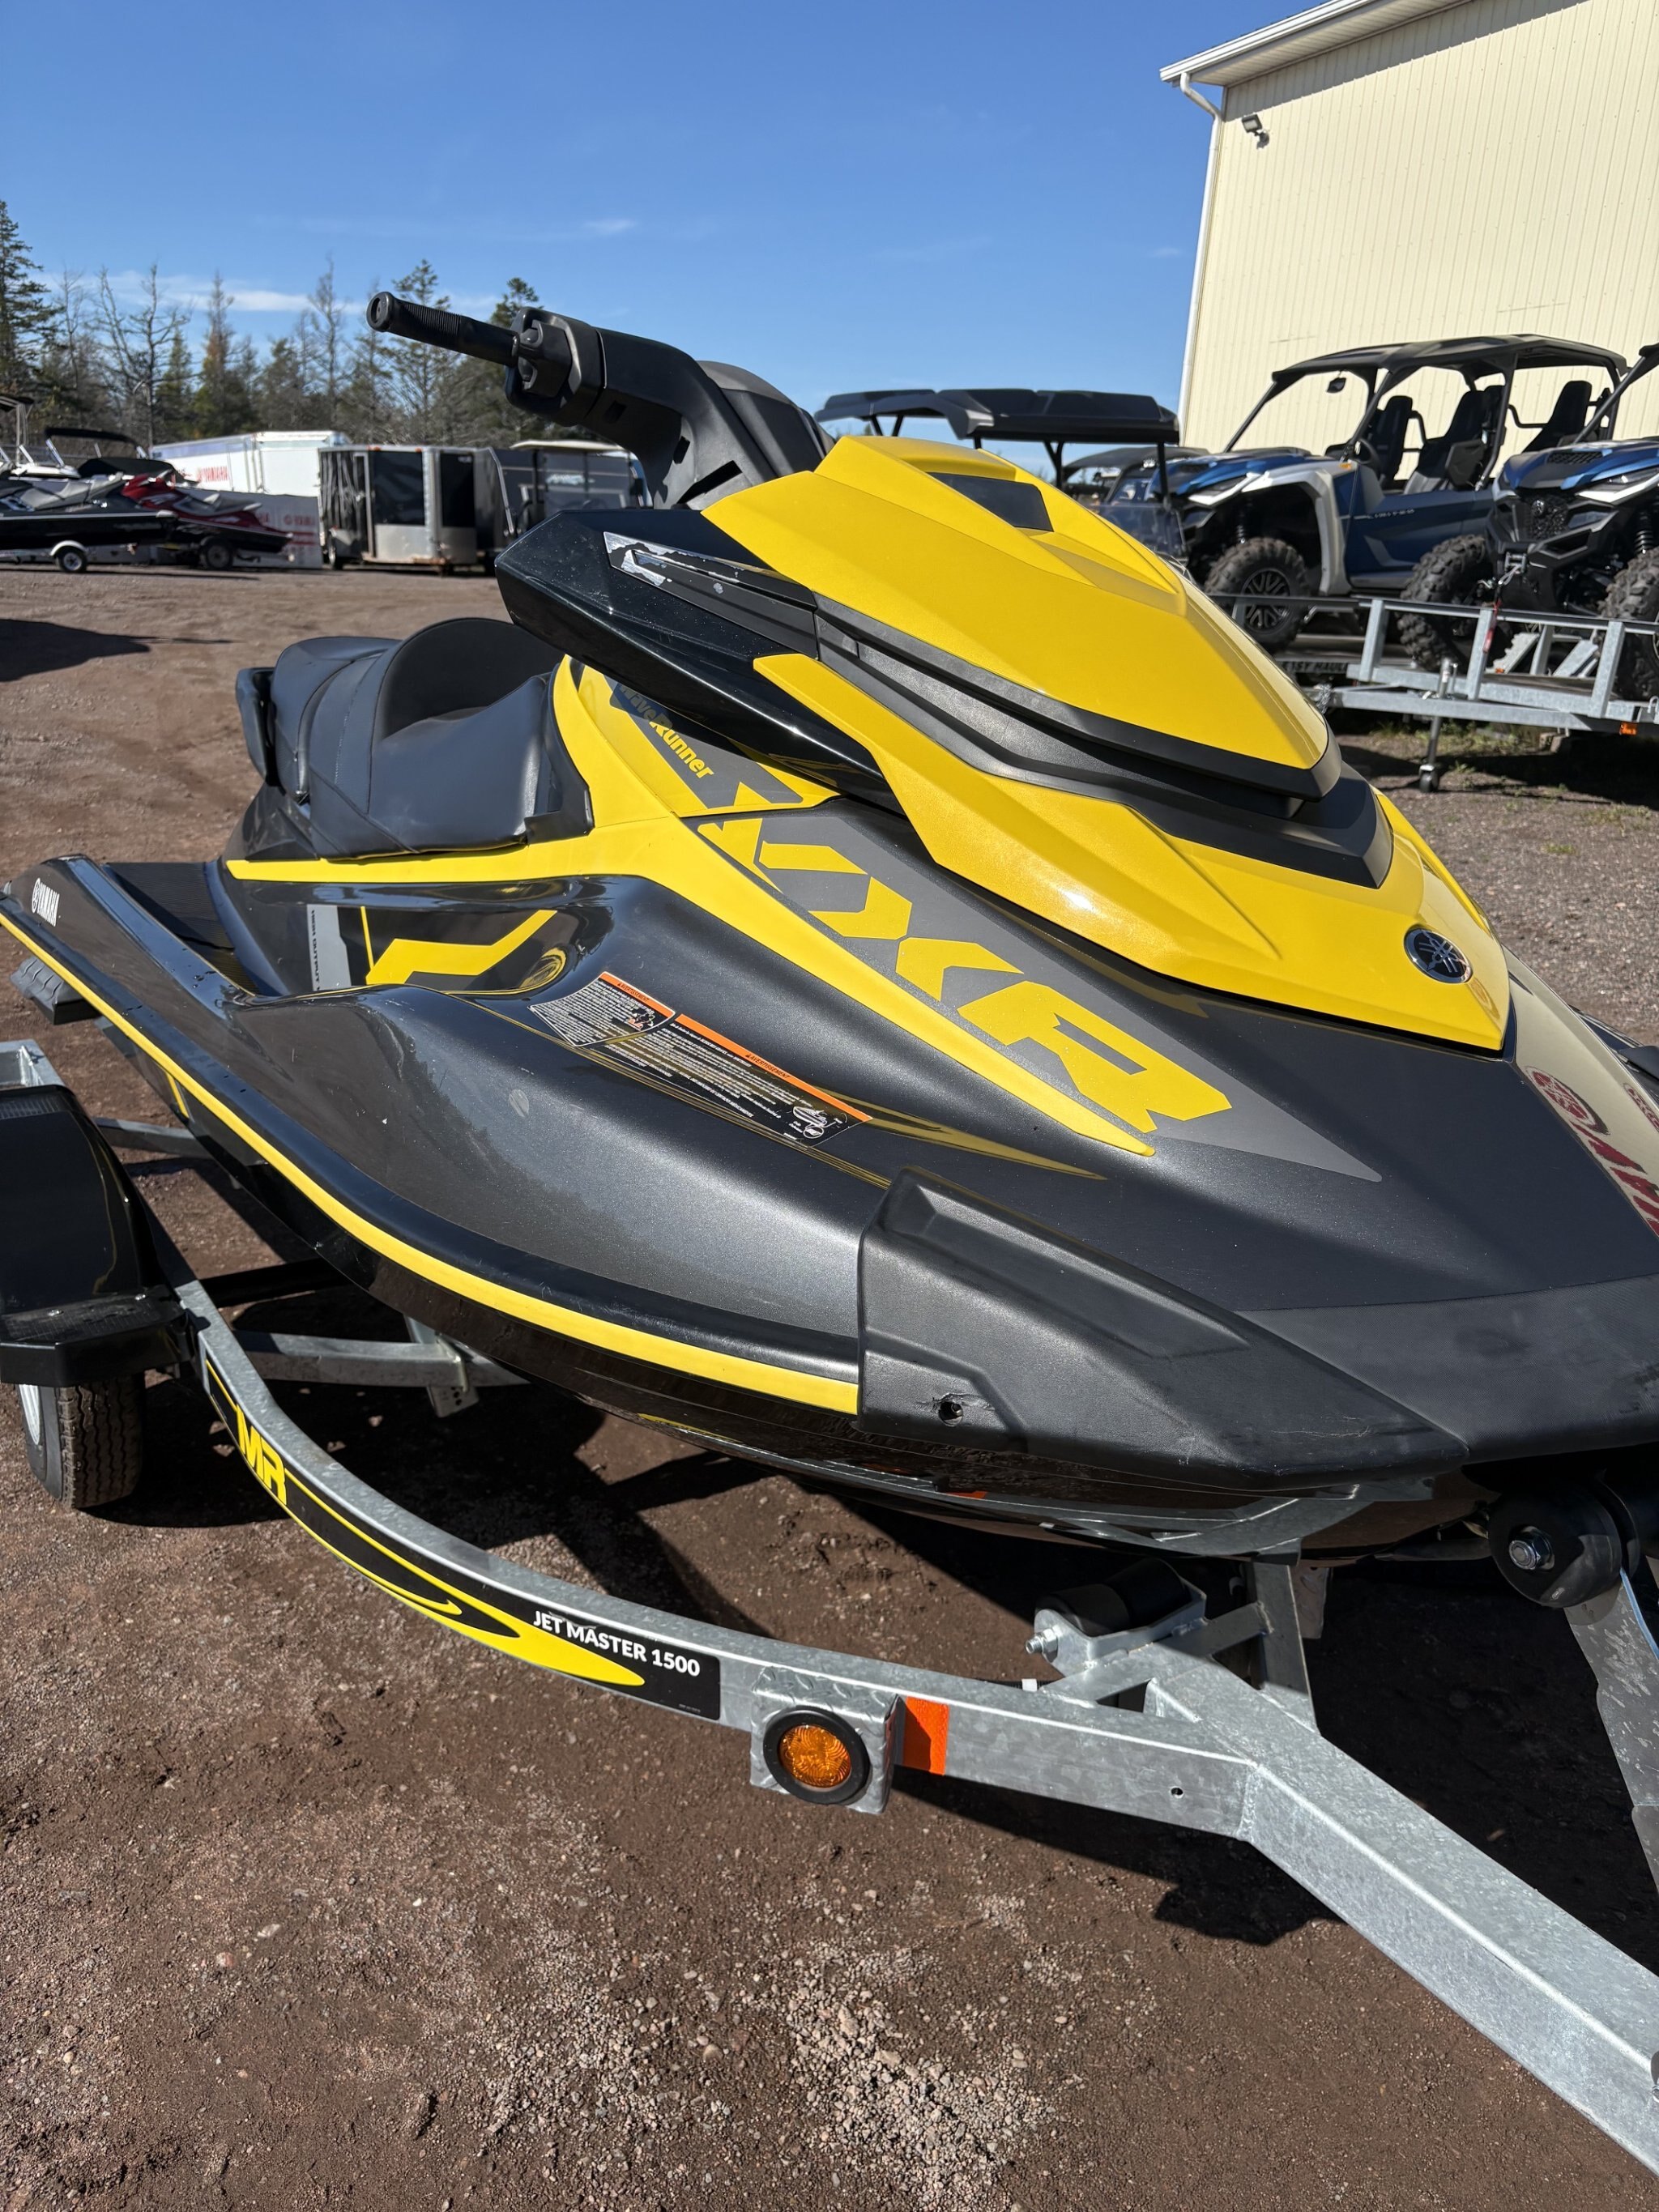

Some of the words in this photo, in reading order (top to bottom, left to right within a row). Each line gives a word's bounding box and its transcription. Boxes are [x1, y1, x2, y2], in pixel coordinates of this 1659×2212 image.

[749, 1056, 791, 1080] AVERTISSEMENT
[533, 1610, 565, 1634] JET
[566, 1620, 647, 1662] MASTER
[651, 1648, 701, 1677] 1500
